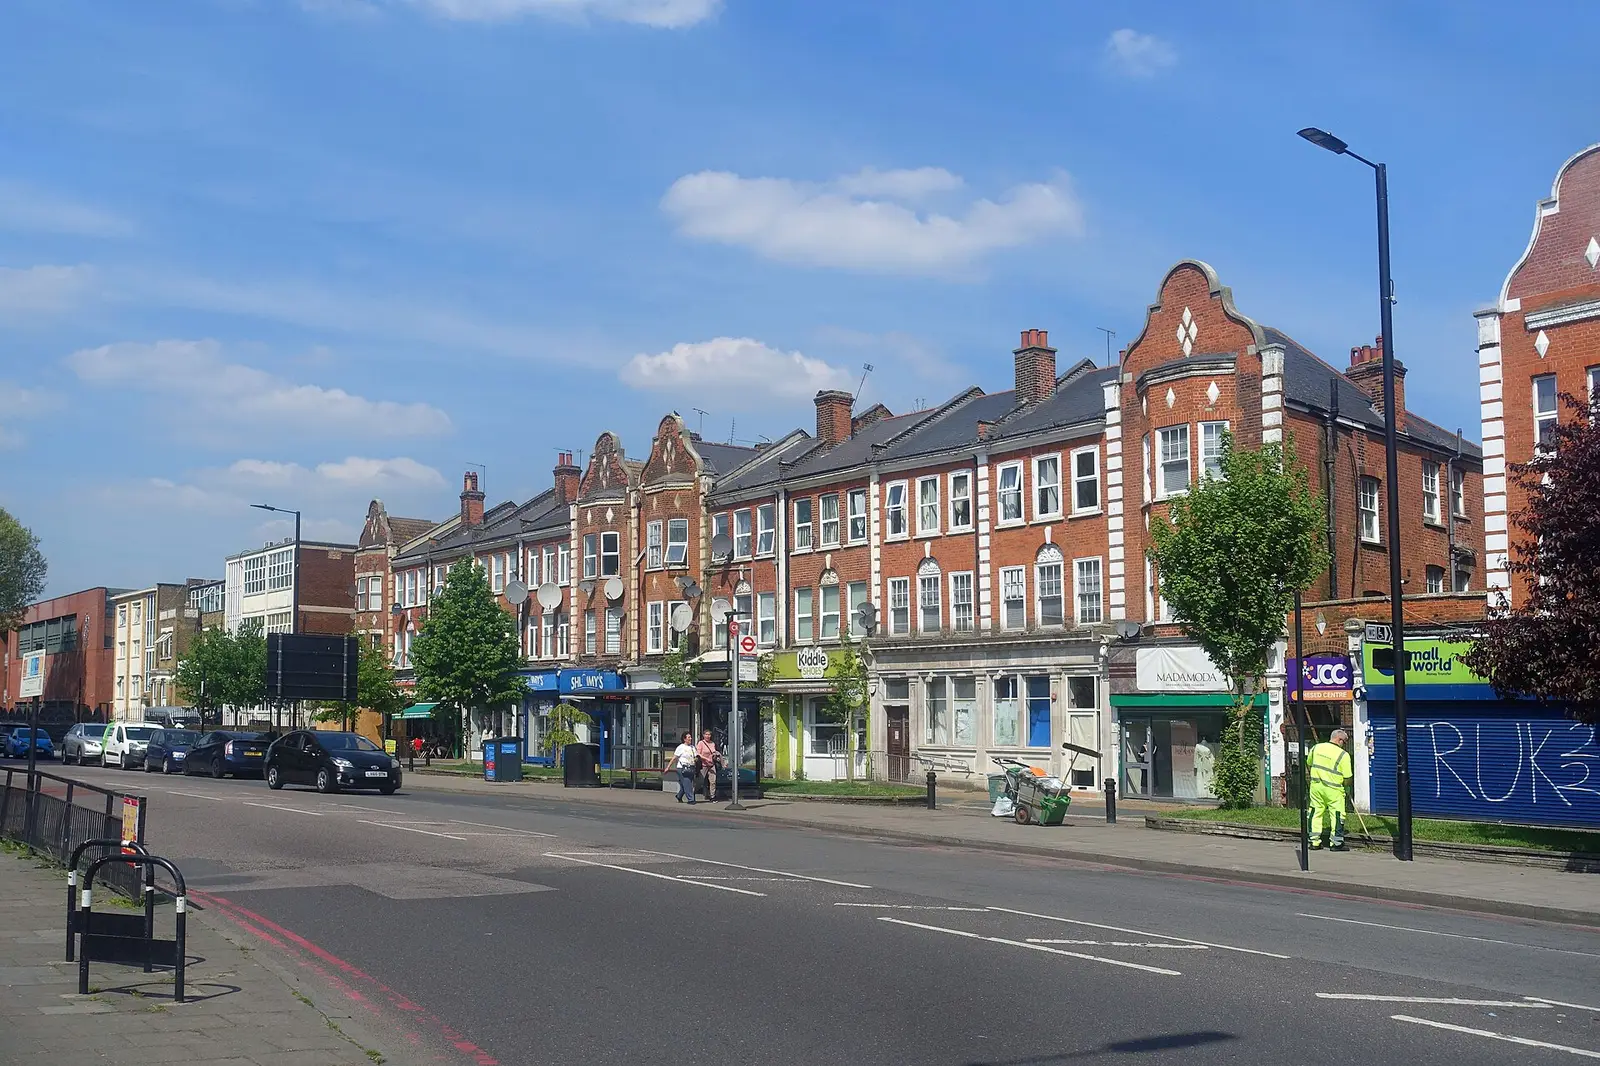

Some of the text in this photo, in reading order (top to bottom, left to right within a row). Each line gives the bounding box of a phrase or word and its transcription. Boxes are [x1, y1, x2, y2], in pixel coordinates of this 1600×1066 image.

[799, 652, 826, 666] Kiddie
[1411, 647, 1439, 660] mall
[1413, 657, 1452, 672] world
[803, 667, 823, 676] SHOES
[1156, 672, 1217, 682] MADAMODA
[1310, 664, 1348, 685] JCC
[1303, 691, 1322, 699] HESED
